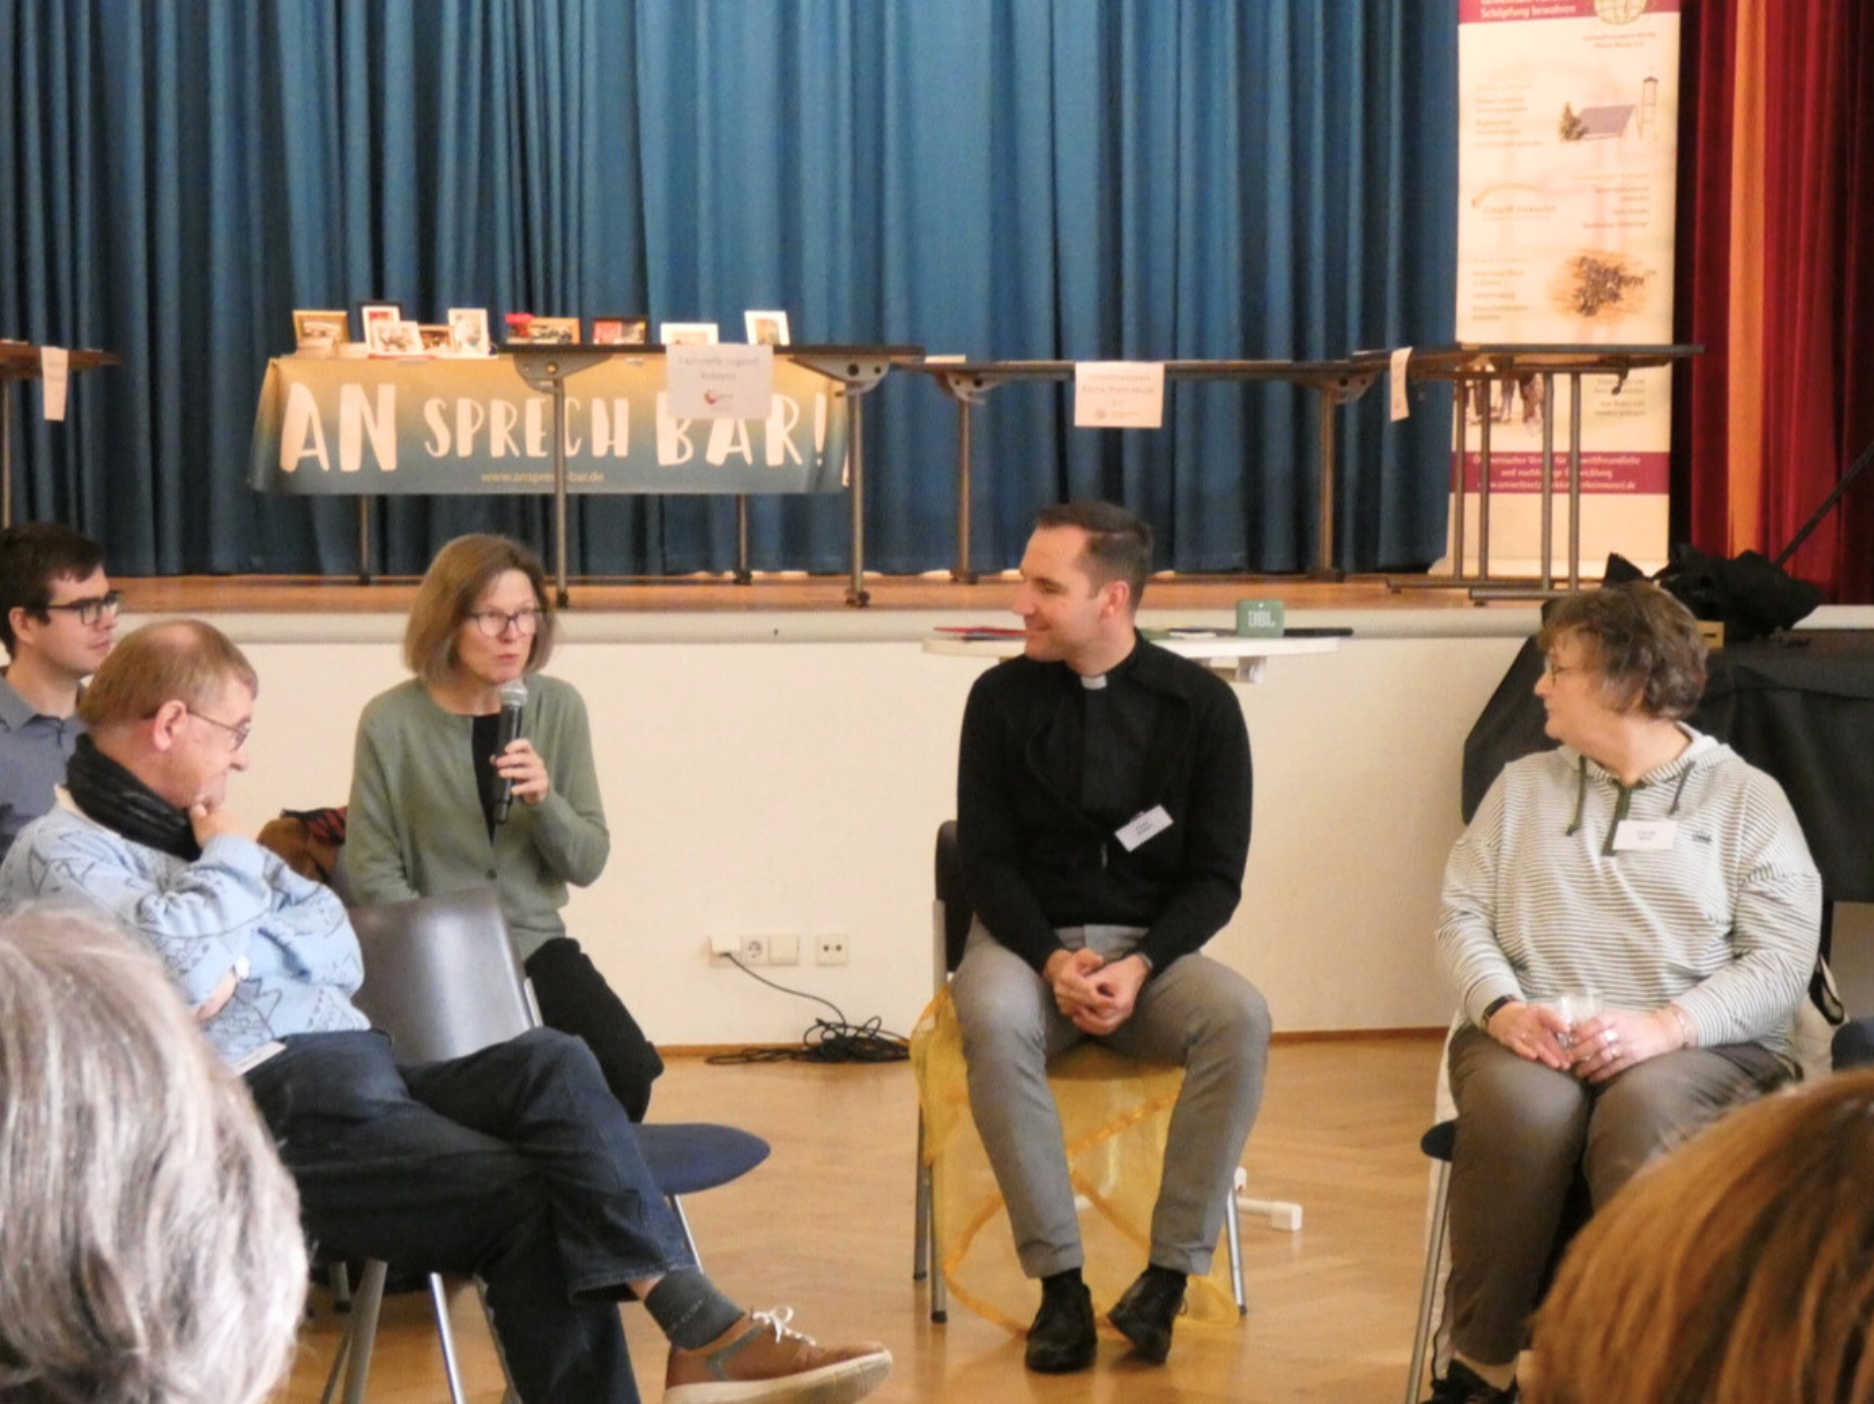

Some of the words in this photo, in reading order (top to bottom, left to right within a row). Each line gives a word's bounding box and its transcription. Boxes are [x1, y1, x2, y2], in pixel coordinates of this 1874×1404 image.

[1481, 6, 1530, 20] Schöpfung
[279, 381, 398, 473] AN
[424, 397, 629, 458] SPRECH
[656, 390, 829, 468] BAR!
